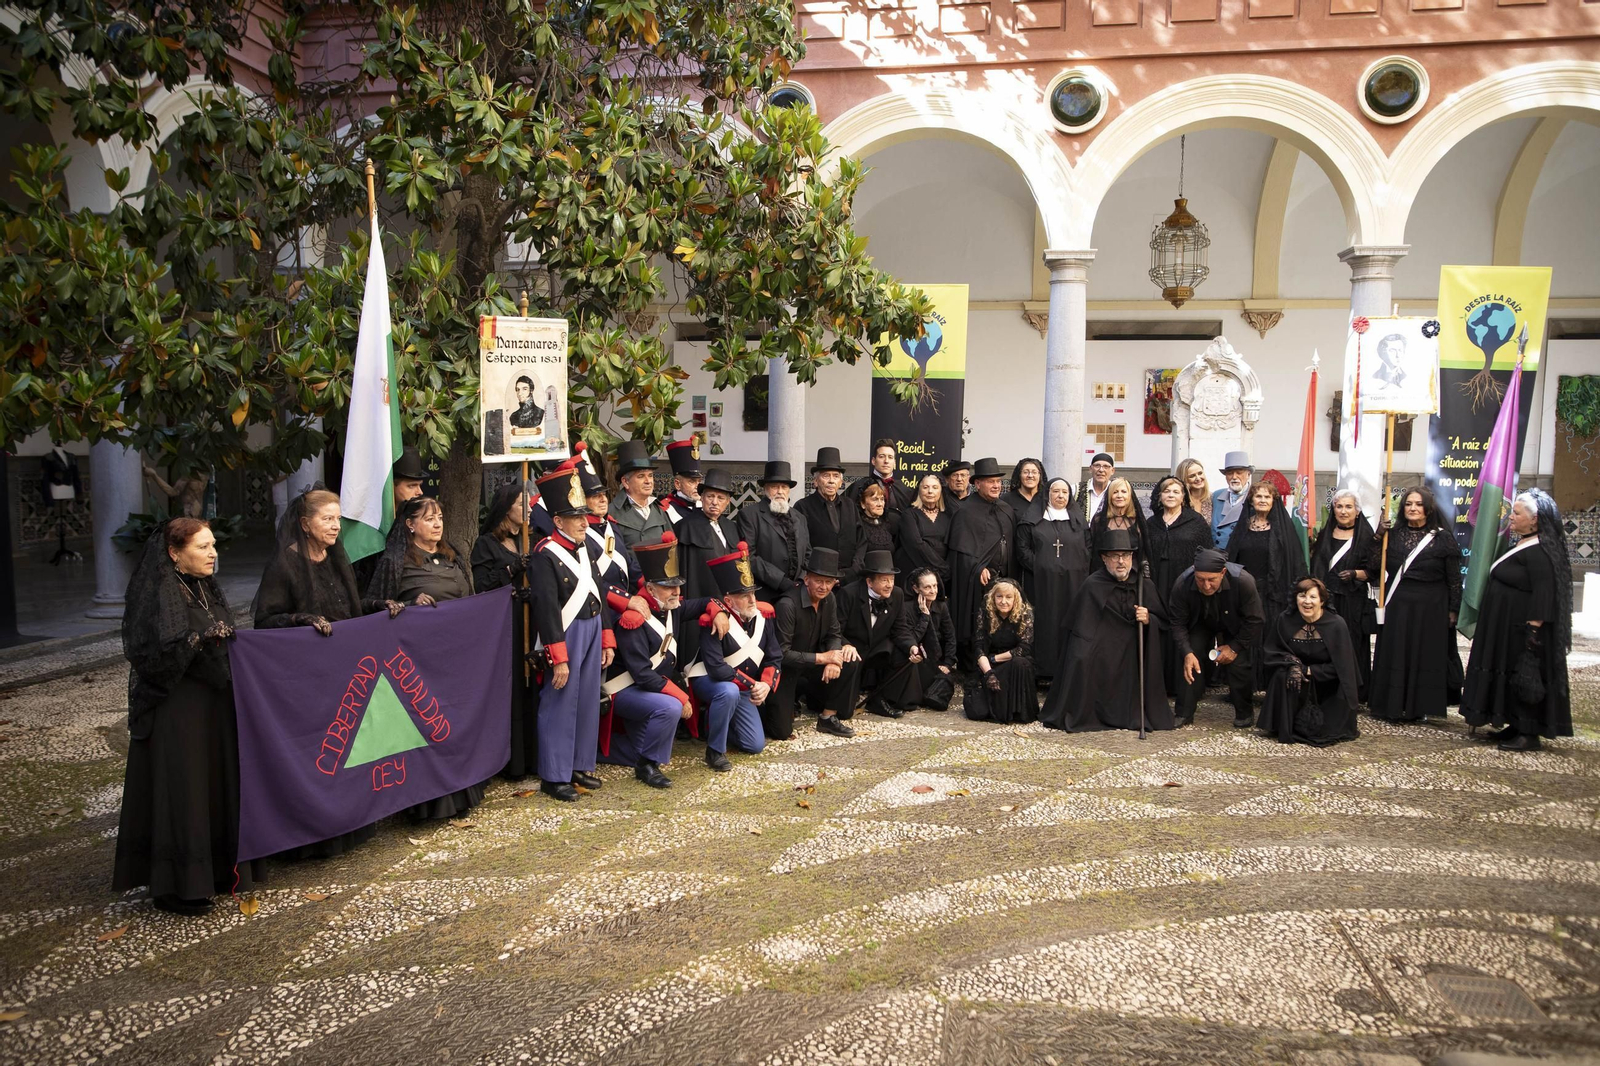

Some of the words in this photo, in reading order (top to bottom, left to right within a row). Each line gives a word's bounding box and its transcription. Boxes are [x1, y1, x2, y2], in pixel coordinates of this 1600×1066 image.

[1464, 294, 1491, 313] DESDE
[1493, 293, 1504, 302] LA
[1505, 296, 1523, 314] RAÍZ
[930, 311, 947, 326] RAÍZ
[485, 351, 537, 366] Estepona
[540, 355, 562, 363] 1831
[1462, 437, 1480, 450] raíz
[899, 457, 908, 471] la
[910, 459, 928, 471] raíz
[931, 459, 949, 472] est
[1438, 455, 1479, 469] situación
[901, 475, 919, 489] tod
[1438, 477, 1452, 488] no
[1454, 473, 1479, 490] pode
[1453, 496, 1463, 505] no
[1455, 509, 1469, 523] nad
[384, 646, 451, 743] IGUALDAD
